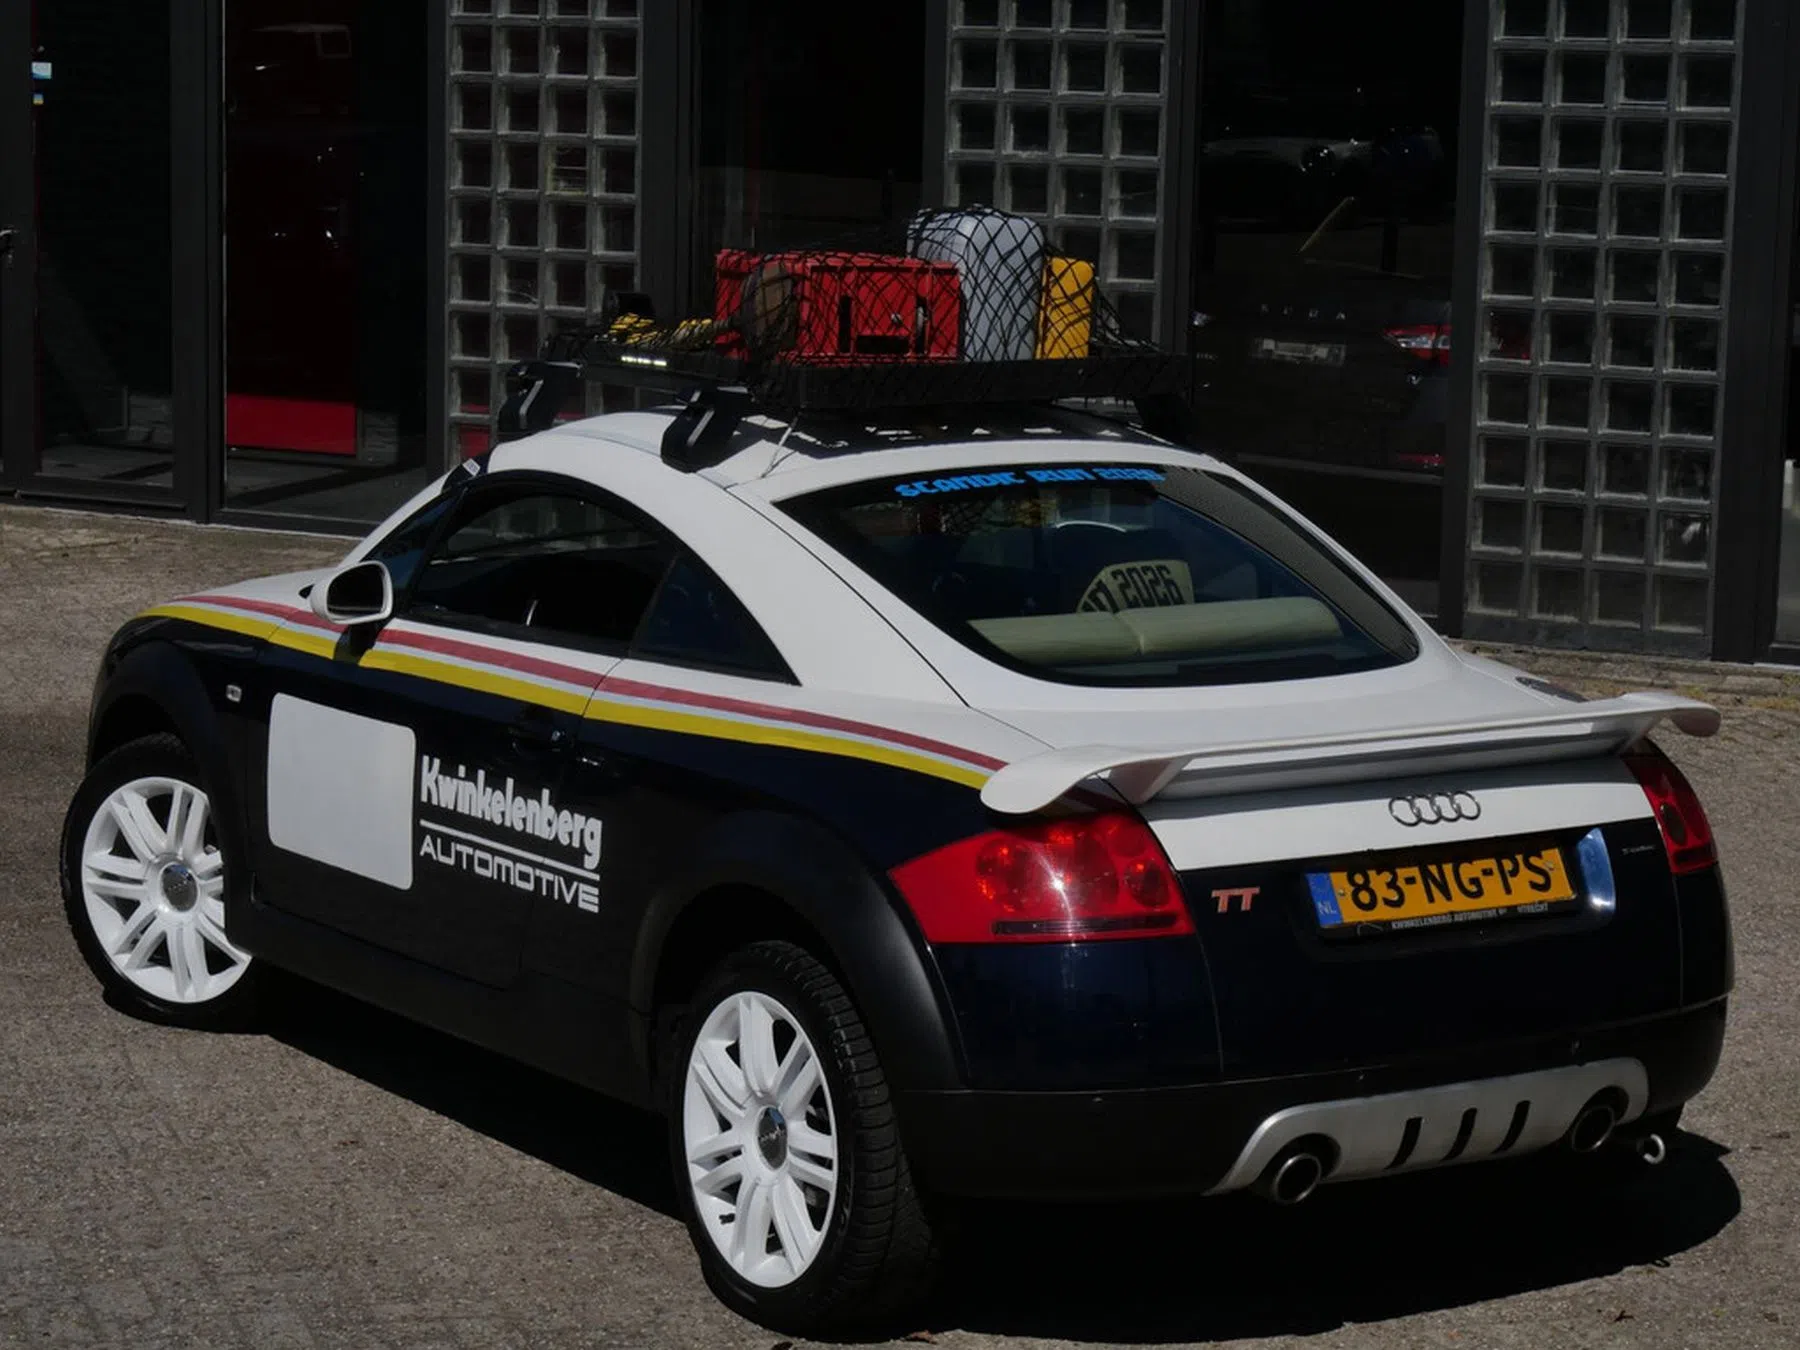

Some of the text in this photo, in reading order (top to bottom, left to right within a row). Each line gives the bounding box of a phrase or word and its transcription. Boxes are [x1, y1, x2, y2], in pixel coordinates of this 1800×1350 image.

[895, 472, 1027, 498] SCANDIC
[1024, 468, 1097, 483] RUN
[1111, 565, 1186, 608] 2026
[420, 754, 603, 870] Kwinkelenberg
[420, 834, 600, 914] AUTOMOTIVE
[1346, 854, 1553, 911] 83-NG-PS
[1211, 886, 1260, 913] TT
[1317, 901, 1337, 915] NL
